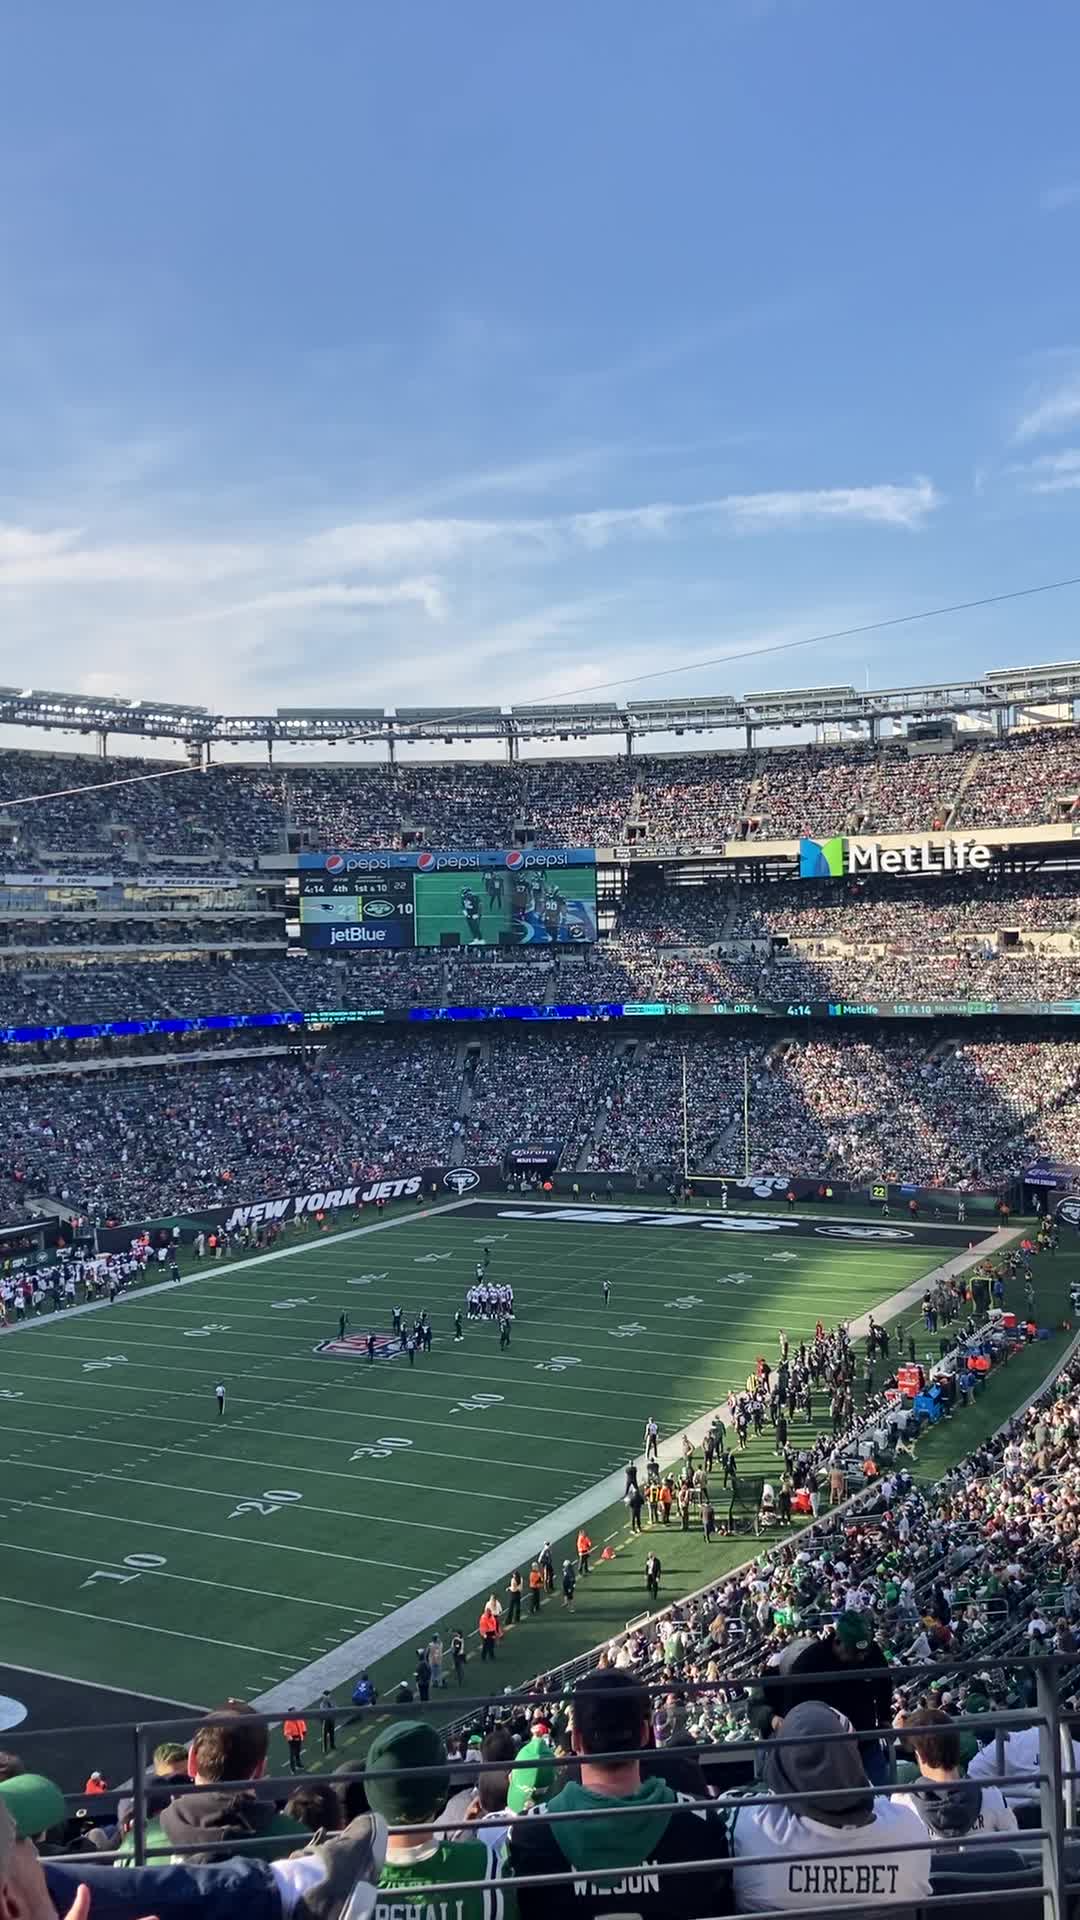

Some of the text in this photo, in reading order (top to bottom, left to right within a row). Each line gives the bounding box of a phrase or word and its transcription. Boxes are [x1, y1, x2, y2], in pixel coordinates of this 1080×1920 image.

[346, 856, 391, 872] pepsi
[437, 854, 480, 870] pepsi
[525, 852, 568, 868] pepsi
[848, 840, 991, 873] MetLife
[304, 885, 326, 894] 4:14
[332, 884, 348, 893] 4th
[354, 884, 368, 893] 1st
[377, 884, 388, 893] 10
[396, 903, 414, 914] 10
[330, 927, 386, 945] jetBlue
[712, 1004, 724, 1014] 10
[734, 1004, 759, 1014] QTR 4
[787, 1005, 812, 1016] 4:14
[843, 1005, 879, 1015] MetLife
[893, 1004, 909, 1014] 1ST
[920, 1004, 932, 1014] 10
[736, 1177, 790, 1190] JETS
[873, 1186, 885, 1197] 22
[228, 1176, 422, 1229] NEW YORK JETS
[497, 1208, 800, 1231] JETS
[533, 1356, 582, 1371] 50
[456, 1393, 505, 1411] 40
[352, 1437, 413, 1459] 30
[235, 1490, 303, 1516] 20
[87, 1553, 167, 1584] 10
[570, 1861, 660, 1896] WSON
[788, 1864, 899, 1894] CHREBET
